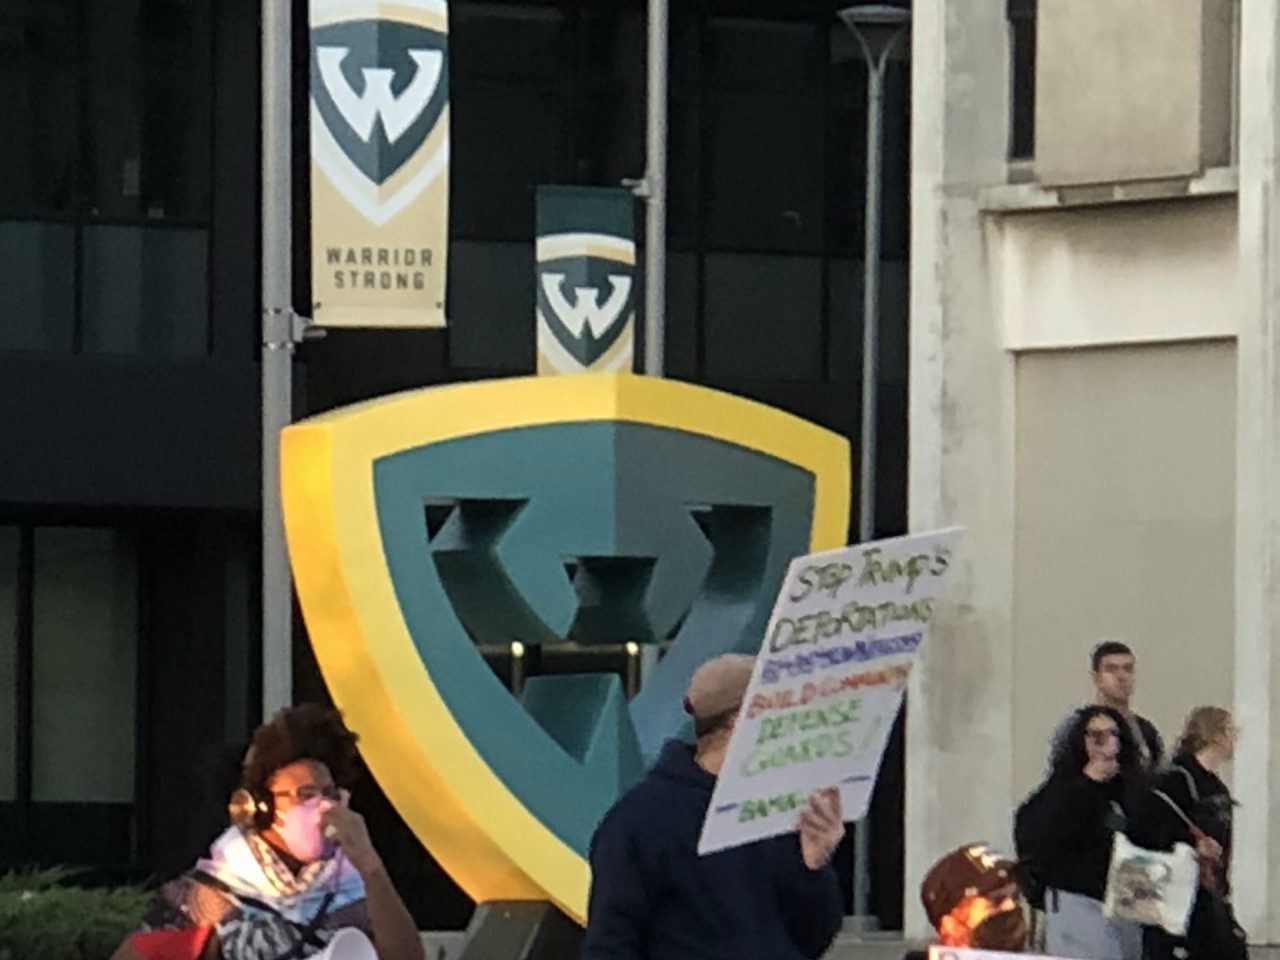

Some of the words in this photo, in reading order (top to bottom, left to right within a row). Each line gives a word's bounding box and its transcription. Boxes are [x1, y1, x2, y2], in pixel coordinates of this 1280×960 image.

[326, 247, 432, 267] WARRIOR
[334, 270, 424, 290] STRONG
[790, 562, 853, 603] STOP
